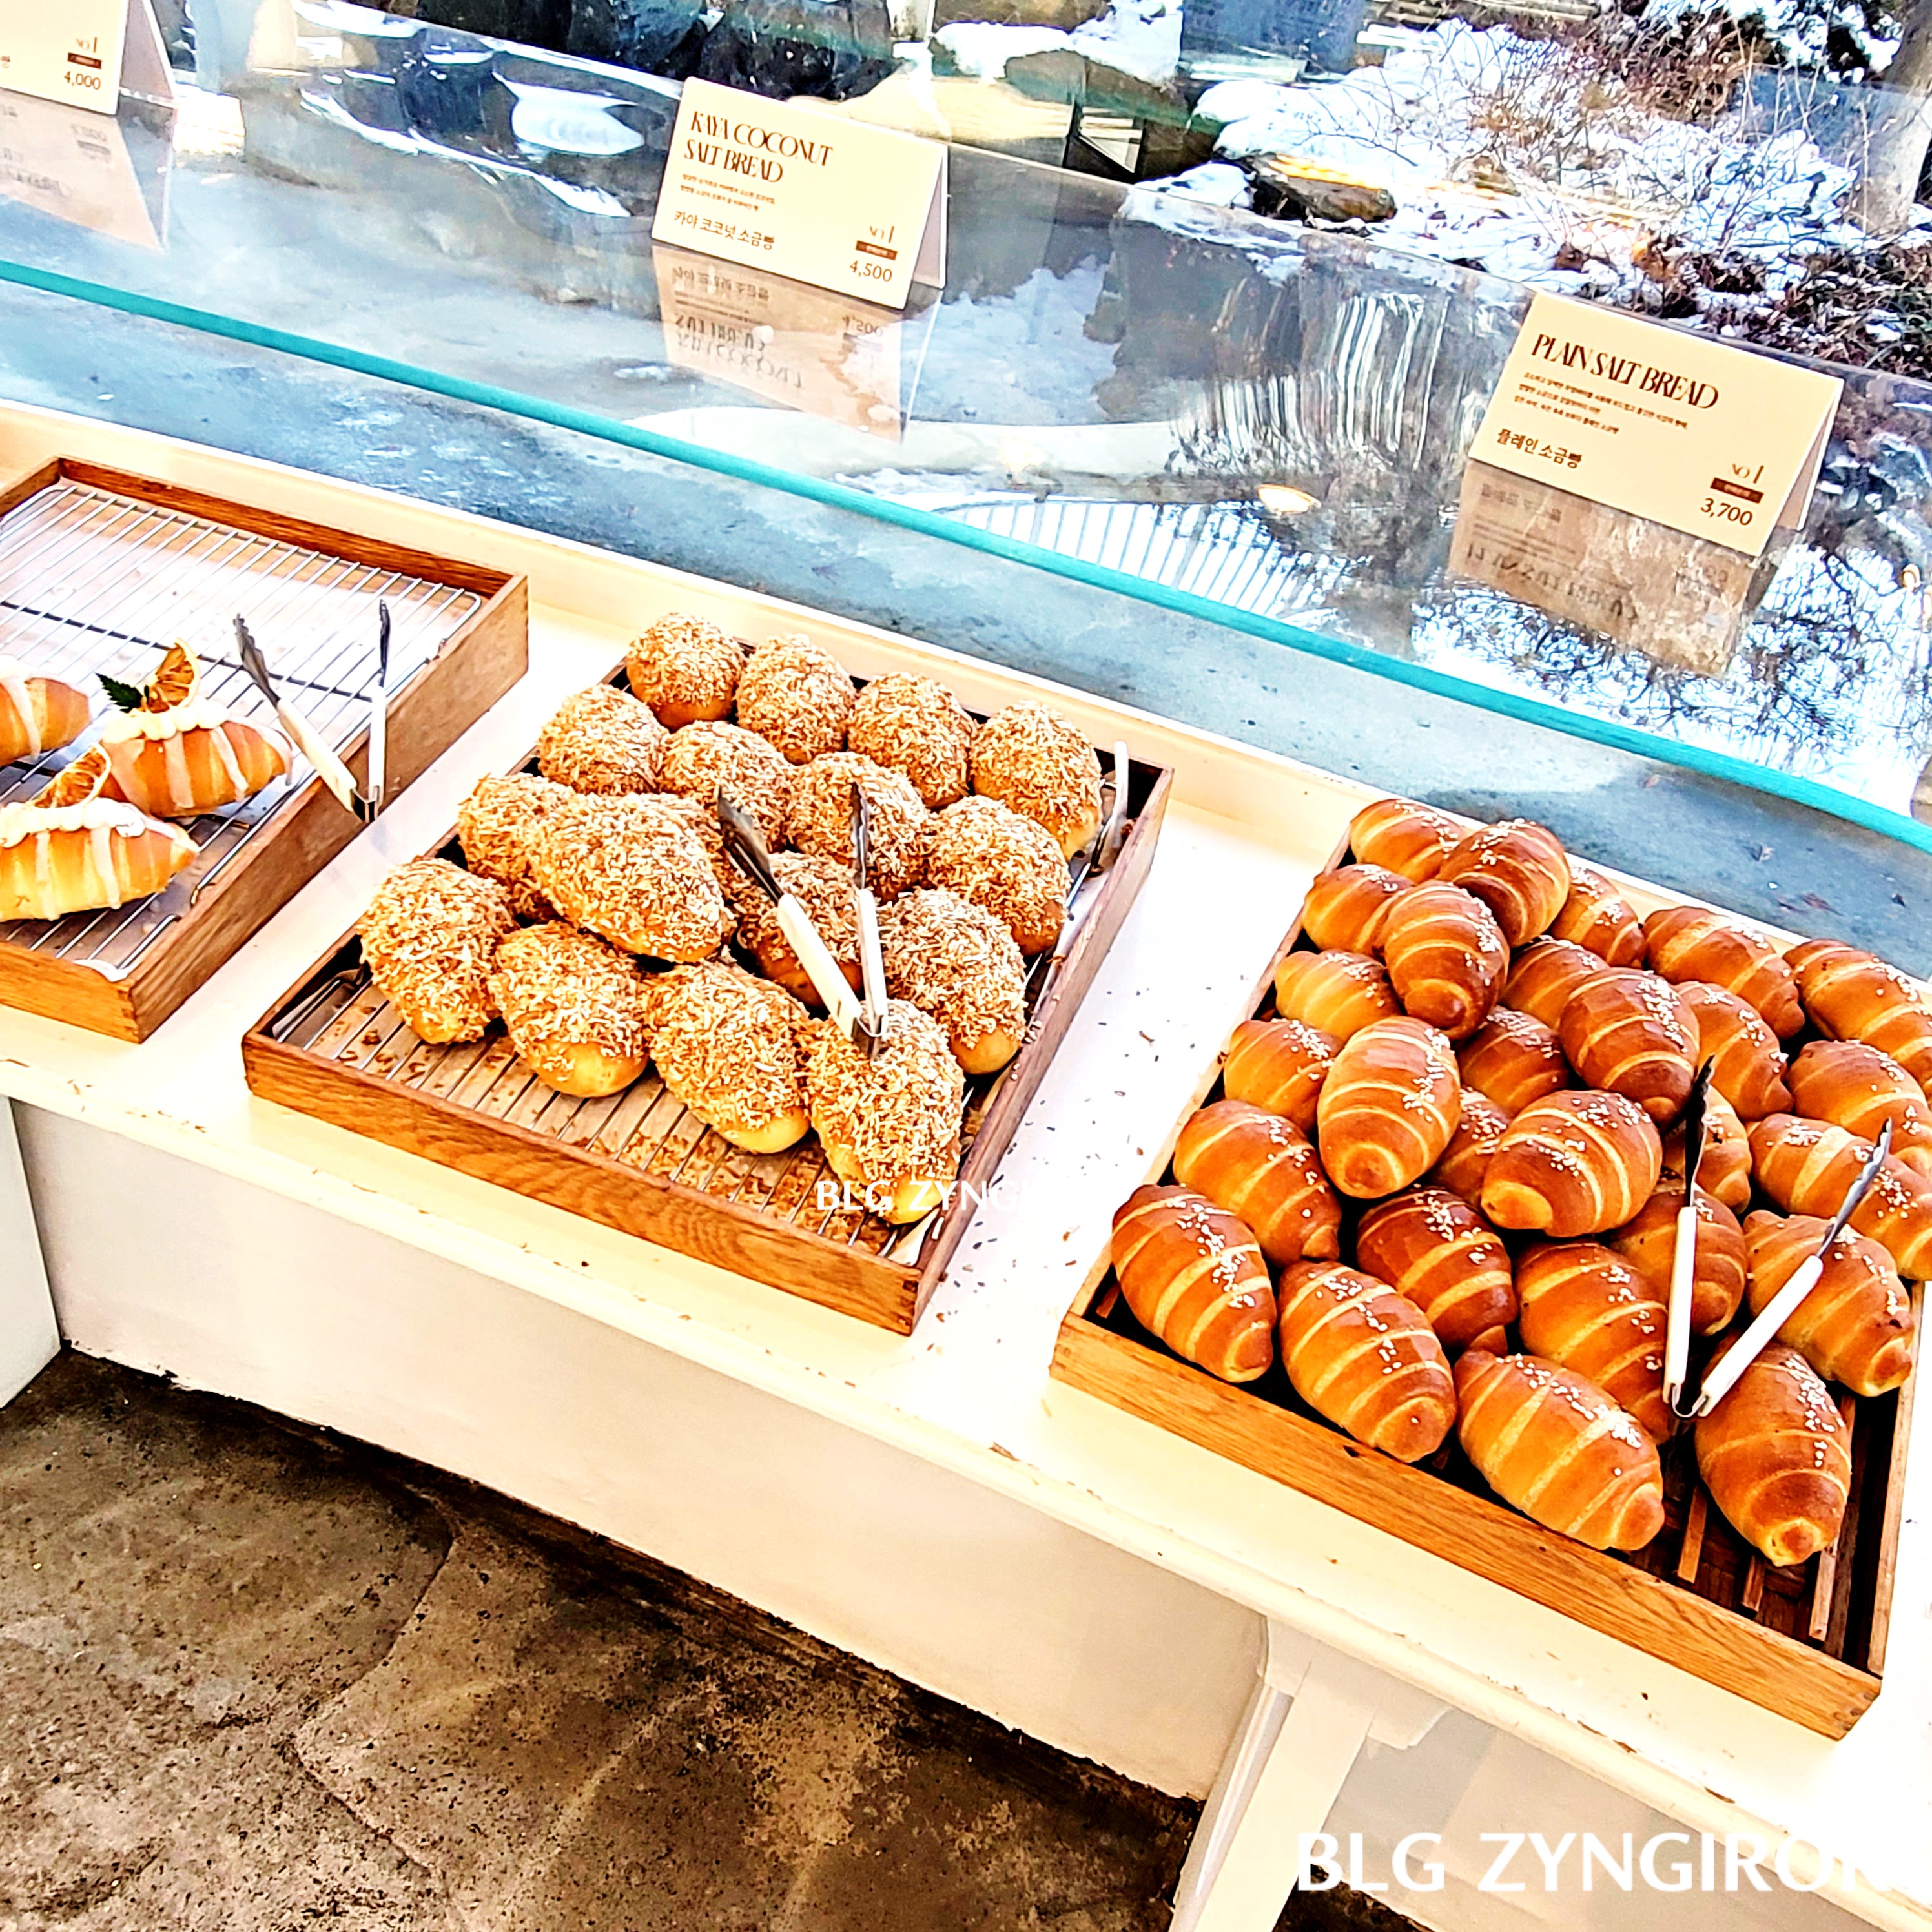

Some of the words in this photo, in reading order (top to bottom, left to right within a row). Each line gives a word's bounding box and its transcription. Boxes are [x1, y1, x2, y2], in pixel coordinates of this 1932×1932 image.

[64, 70, 101, 90] 4,000
[690, 110, 728, 140] KAYA
[733, 123, 834, 167] COCONUT
[684, 138, 723, 166] SALT
[723, 149, 784, 183] BREAD
[674, 211, 698, 229] 카야
[699, 218, 736, 240] 코코넛
[737, 229, 775, 251] 소금빵
[849, 260, 893, 282] 4,500
[1532, 333, 1594, 371] PLAIN
[1590, 352, 1643, 385] SALT
[1639, 367, 1719, 409] BREAD
[1497, 428, 1539, 455] 플레인
[1538, 444, 1583, 469] 소금빵
[1700, 497, 1753, 526] 3,700
